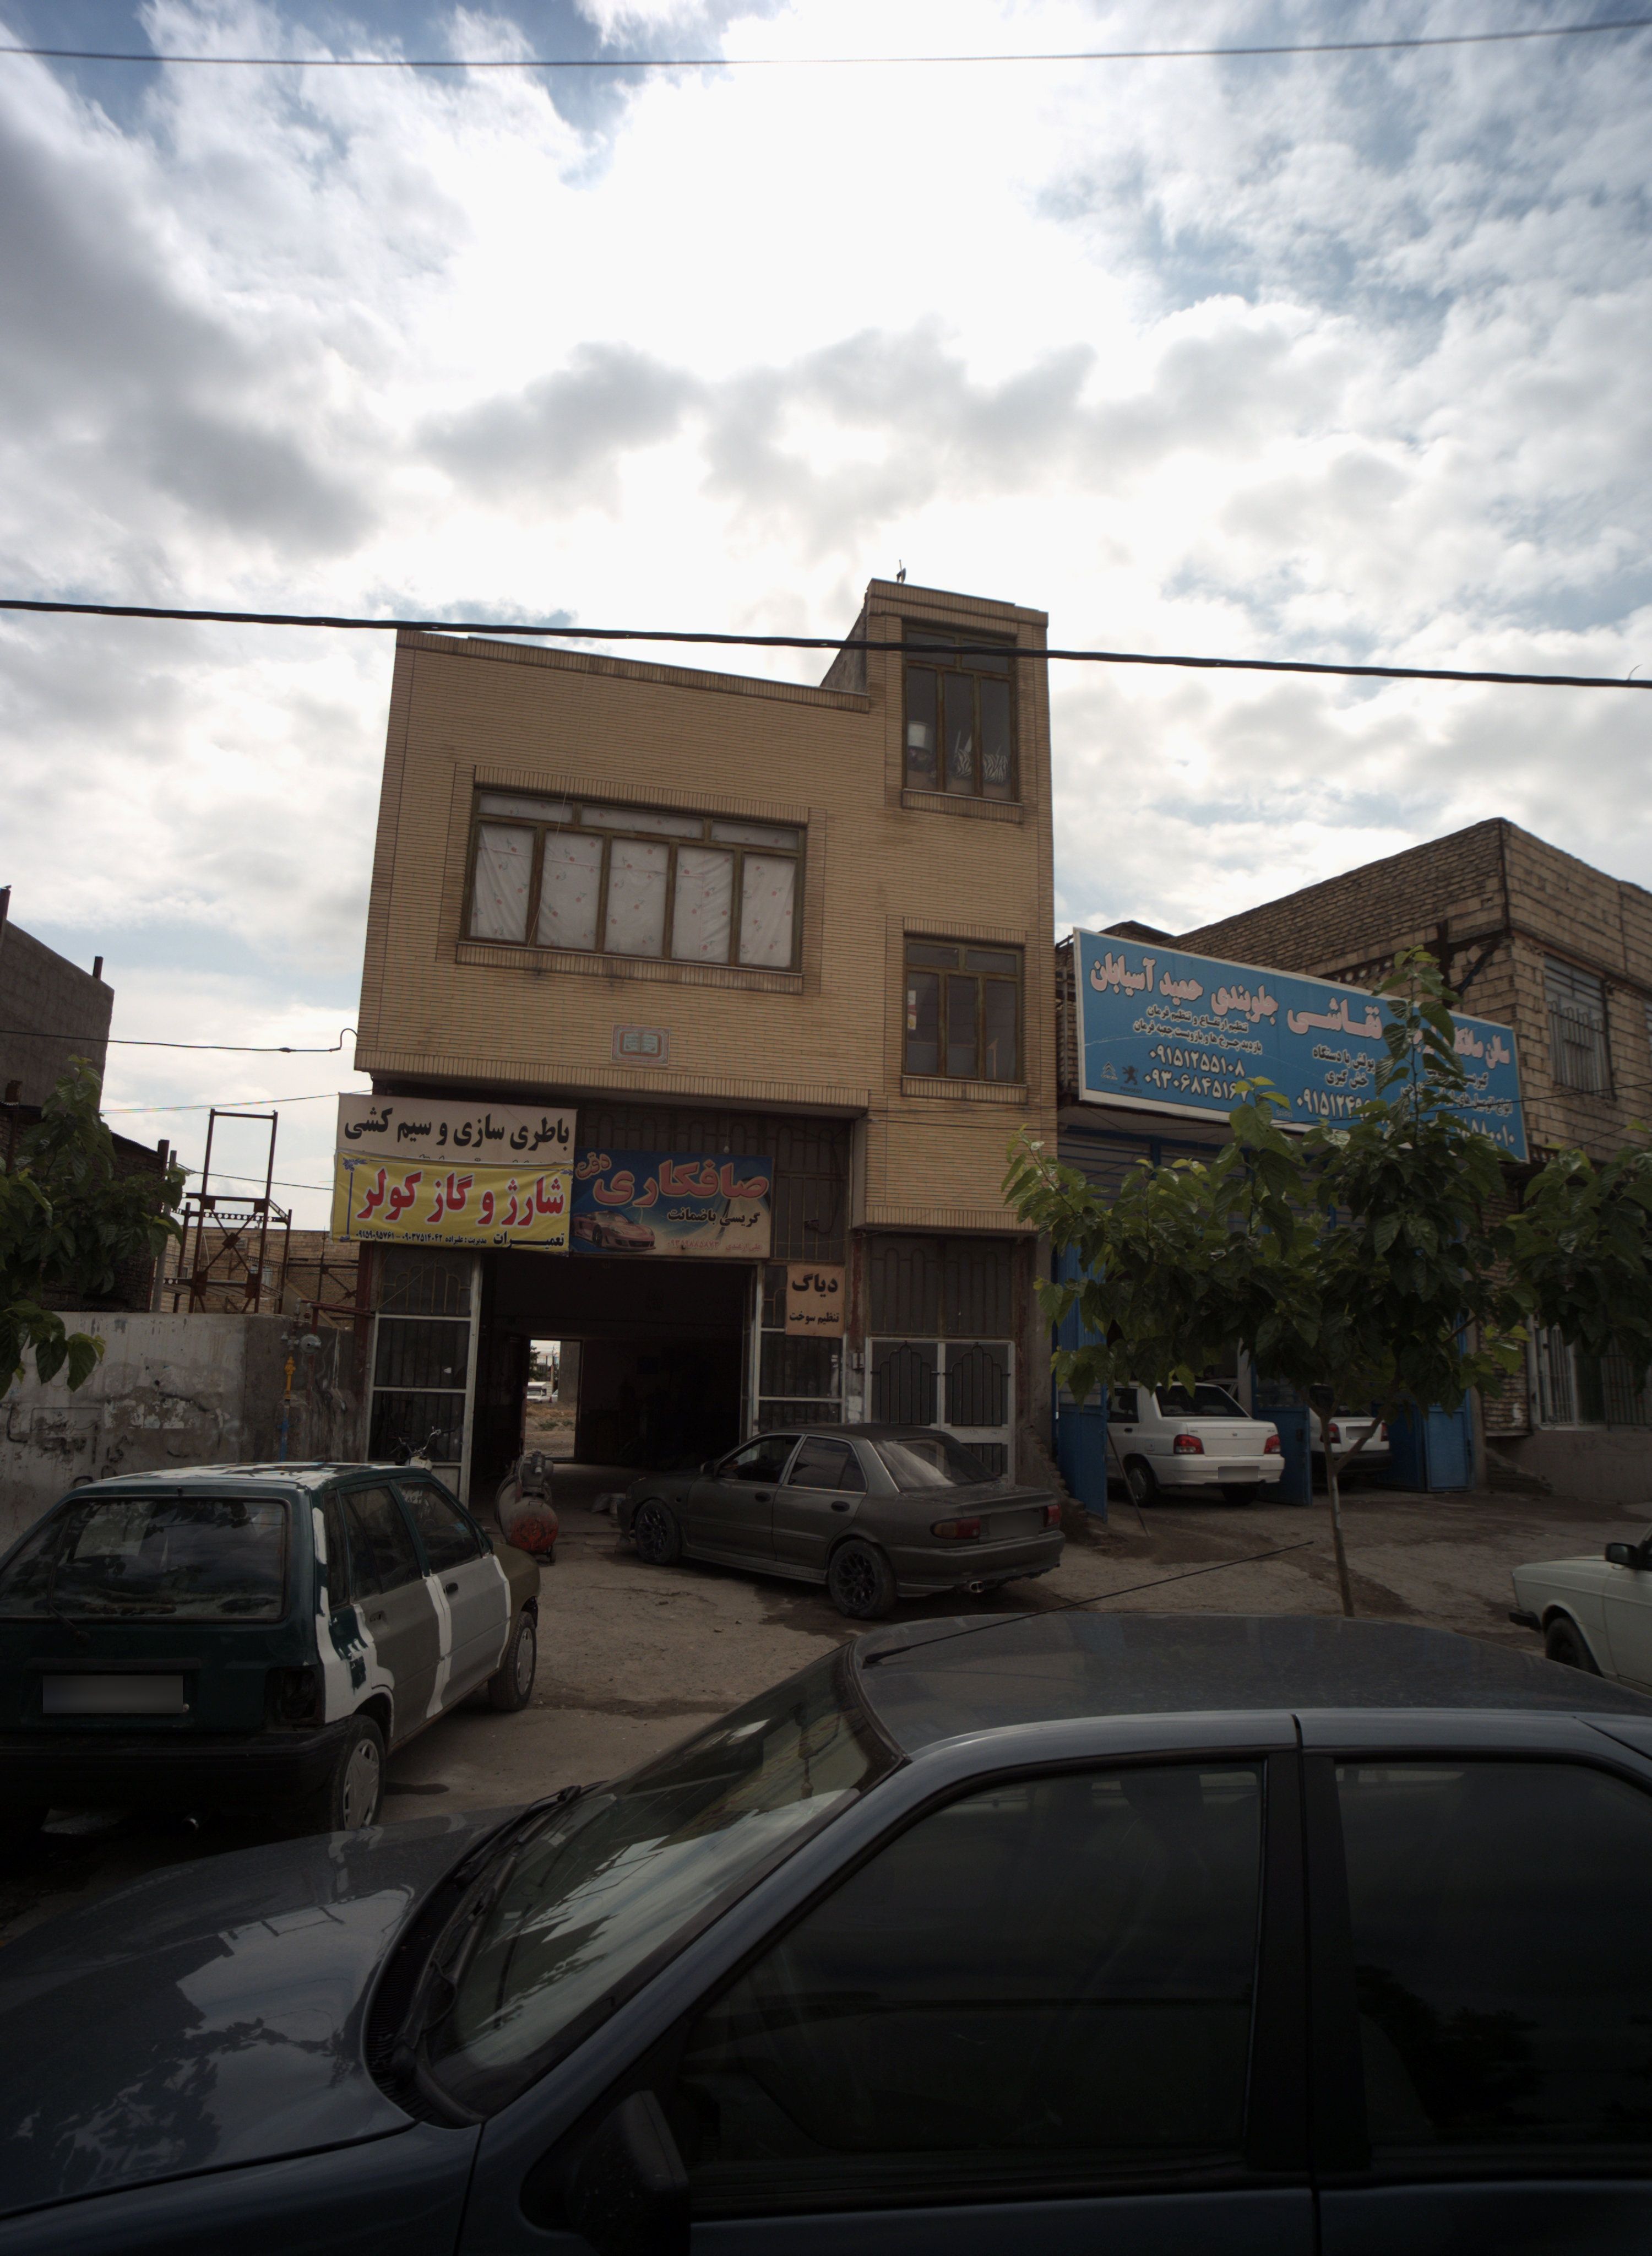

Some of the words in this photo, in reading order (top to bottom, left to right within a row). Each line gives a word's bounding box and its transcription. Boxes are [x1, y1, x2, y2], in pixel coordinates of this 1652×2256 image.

[1090, 952, 1156, 996] آسیابان
[1159, 972, 1203, 1005] حمید
[1146, 1004, 1170, 1020] فرمان
[1171, 1008, 1192, 1022] تنظیم
[1211, 985, 1279, 1025] جلوبندی
[1133, 1018, 1155, 1035] فرمان
[1192, 1016, 1198, 1026] و
[1199, 1014, 1228, 1031] ارتفاع
[1229, 1020, 1249, 1033] تنظیم
[1287, 997, 1383, 1040] نقاشی
[1156, 1023, 1172, 1038] جعبه
[1209, 1032, 1217, 1043] ها
[1242, 1040, 1262, 1055] بازدید
[1312, 1044, 1343, 1063] دستگاه
[1149, 1043, 1246, 1077] ۰۹۱۵۱۲۵۵۱۰۸
[1325, 1069, 1349, 1087] گیری
[1350, 1071, 1369, 1089] خش
[345, 1107, 393, 1140] کشی
[397, 1121, 432, 1143] سیم
[454, 1113, 504, 1147] سازی
[436, 1122, 448, 1146] و
[510, 1117, 569, 1151] باطری
[575, 1152, 611, 1180] دقت
[593, 1159, 769, 1208] صافکاری
[356, 1168, 422, 1221] کولر
[427, 1173, 474, 1222] گاز
[501, 1178, 564, 1226] شارژ
[477, 1191, 494, 1225] و
[720, 1211, 760, 1227] گریسی
[356, 1230, 394, 1240] ۰۹۱۵۹۰۹۵۷۶۱
[445, 1235, 464, 1245] علیزاده
[792, 1273, 838, 1298] دیاگ
[790, 1311, 816, 1325] سوخت
[817, 1312, 839, 1325] تنظیم
